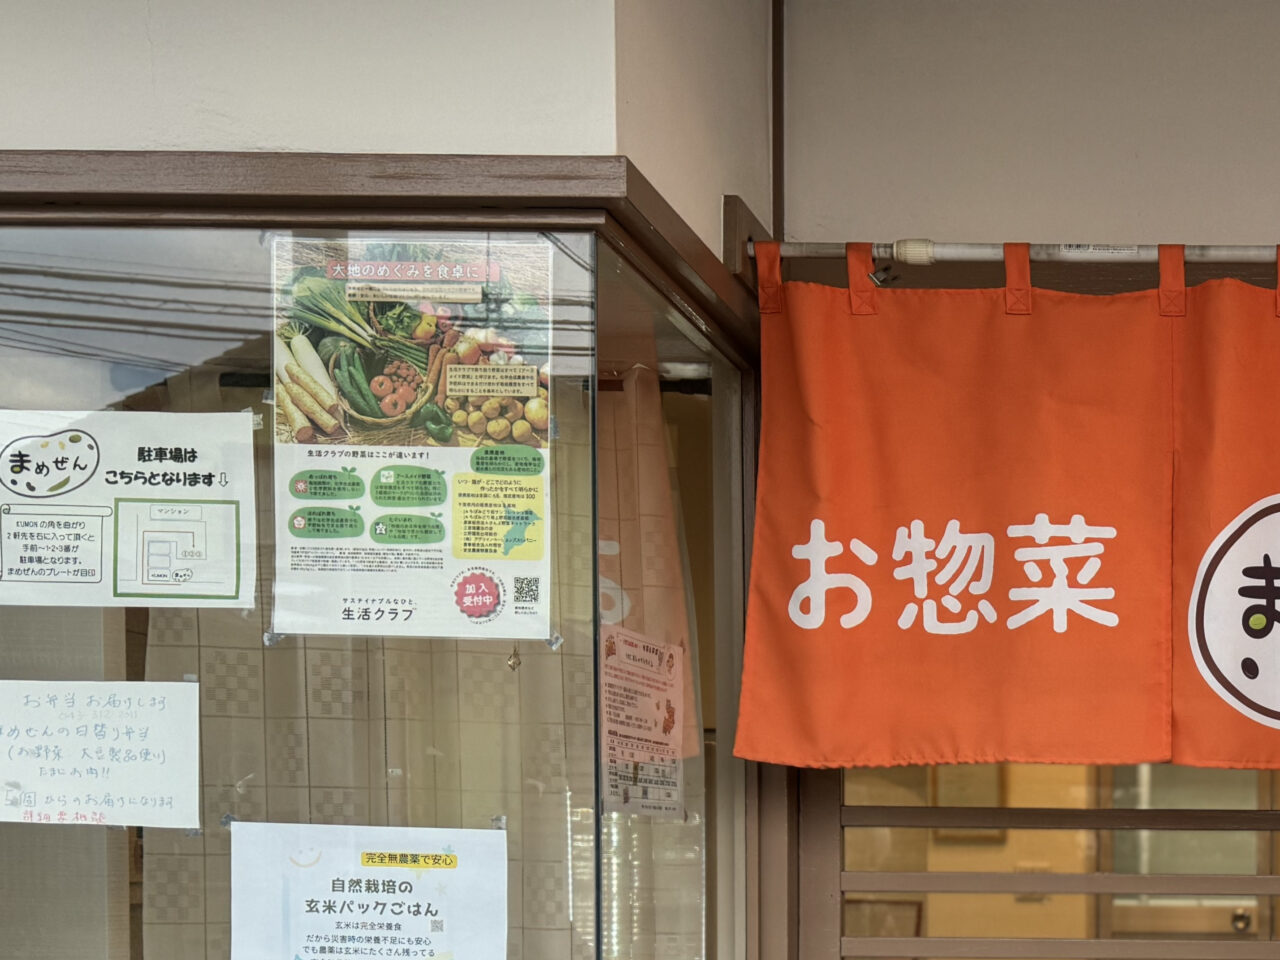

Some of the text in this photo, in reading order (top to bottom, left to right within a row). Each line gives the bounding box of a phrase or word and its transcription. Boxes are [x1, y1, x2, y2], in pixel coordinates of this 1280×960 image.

[9, 450, 88, 477] まめぜん
[137, 446, 198, 464] 駐車場は
[104, 470, 215, 487] こちらとなります
[788, 513, 1119, 634] お惣菜
[342, 607, 417, 622] 生活クラブ
[366, 852, 453, 866] 完全無農薬で安心
[331, 877, 413, 894] 自然栽培の
[305, 899, 439, 917] 玄米パックごはん
[335, 921, 402, 931] 玄米は完全栄養食
[306, 934, 431, 946] だから災害時の栄養不足にも安心
[302, 945, 435, 957] でも農薬は玄米にたくさん残ってる
